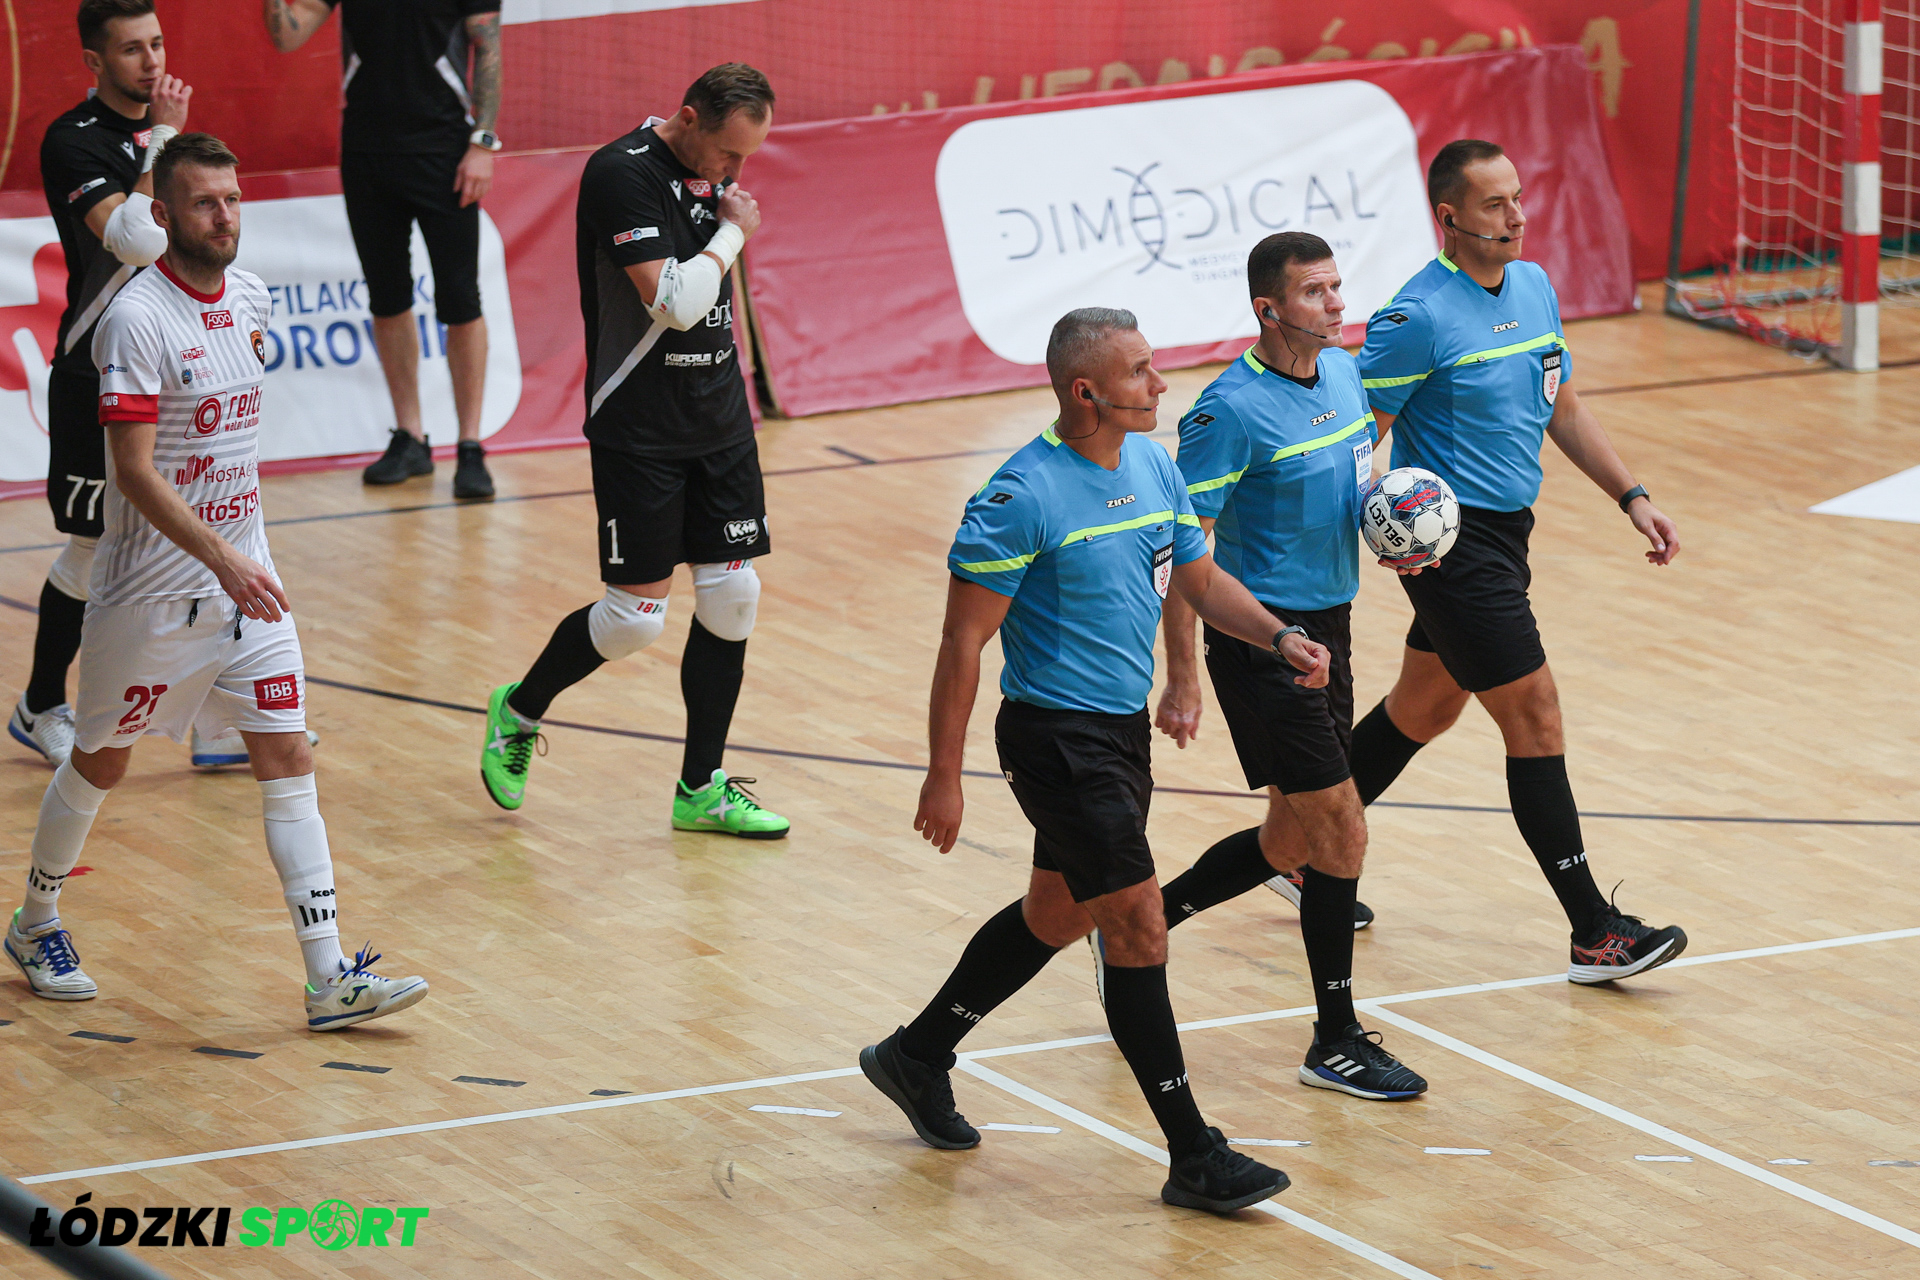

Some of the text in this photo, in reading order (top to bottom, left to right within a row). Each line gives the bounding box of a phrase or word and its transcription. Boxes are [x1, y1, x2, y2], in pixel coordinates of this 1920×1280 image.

[1355, 443, 1371, 462] FIFA
[66, 474, 106, 521] 77
[606, 518, 625, 565] 1
[1369, 501, 1406, 548] SELECT
